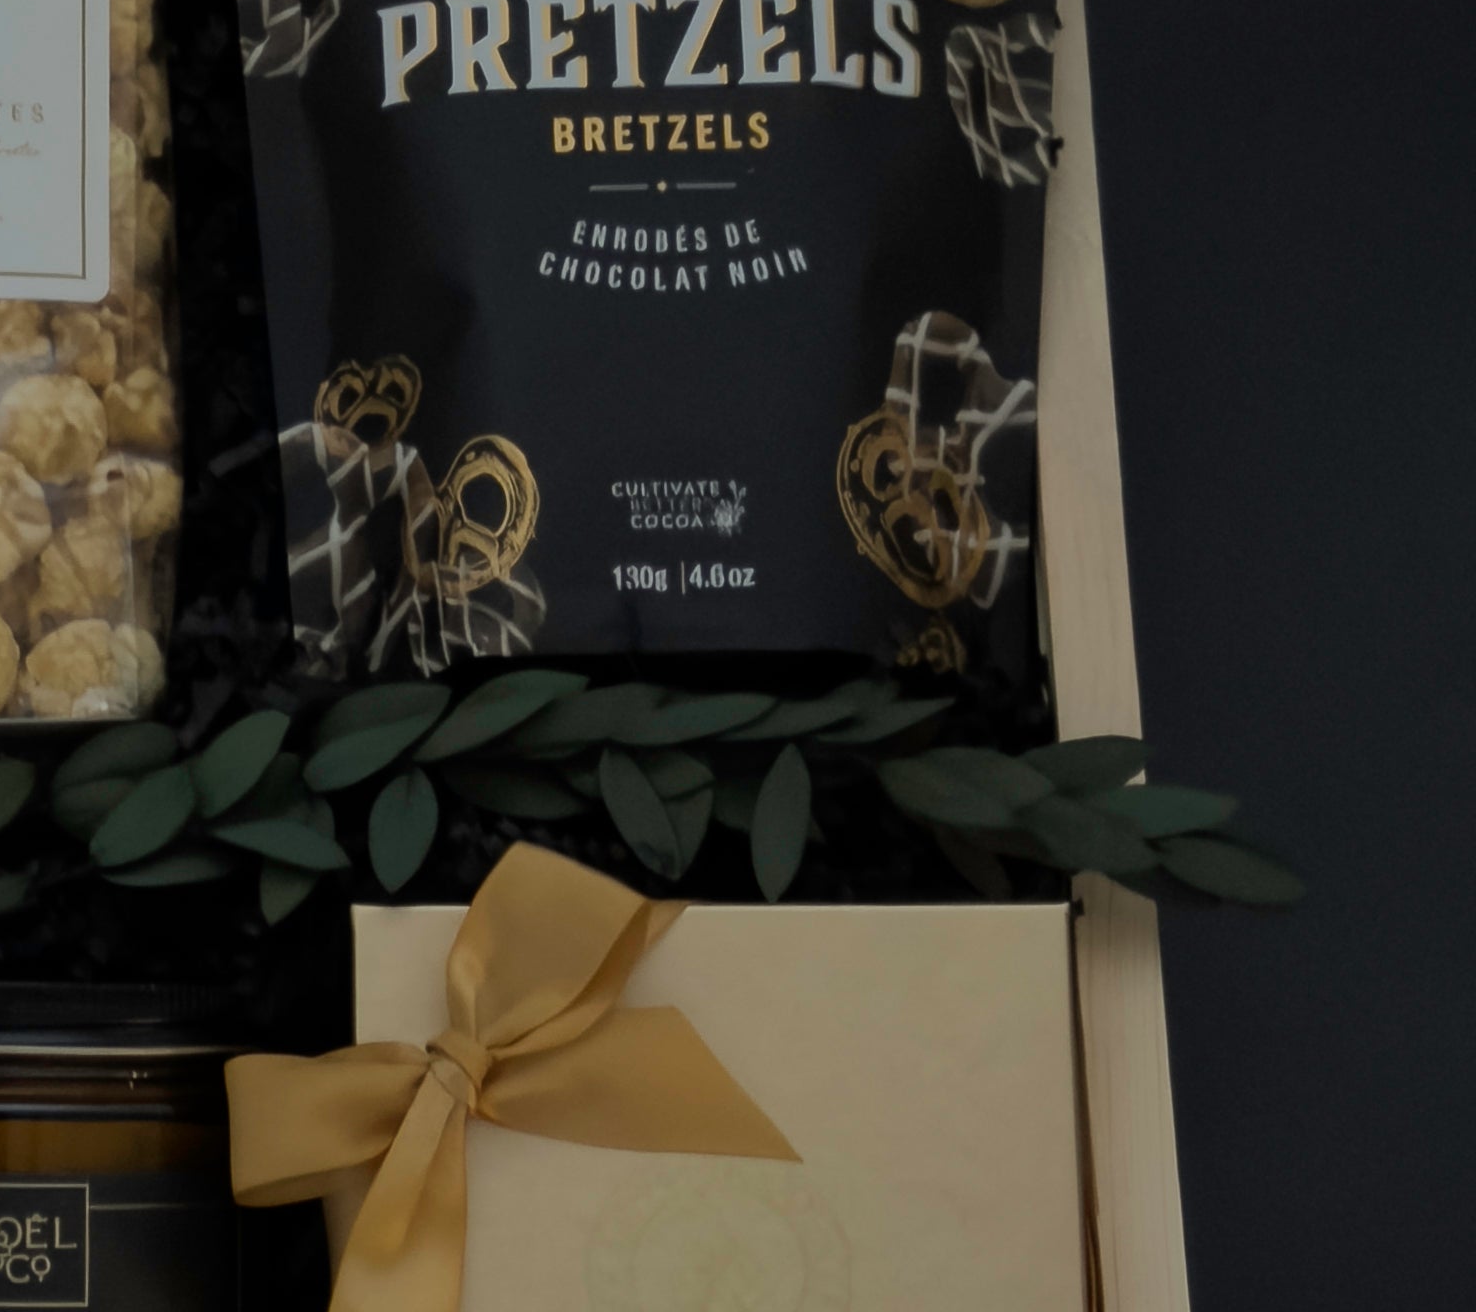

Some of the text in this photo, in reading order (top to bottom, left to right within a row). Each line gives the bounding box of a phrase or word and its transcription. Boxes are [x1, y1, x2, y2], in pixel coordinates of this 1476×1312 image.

[553, 111, 771, 153] BRETZELS
[573, 219, 760, 253] ENROBÉS DE
[539, 247, 808, 292] CHOCOLAT NOIR
[611, 480, 719, 498] CULTIVATE
[631, 514, 703, 529] COCOA
[613, 564, 667, 592] 130g
